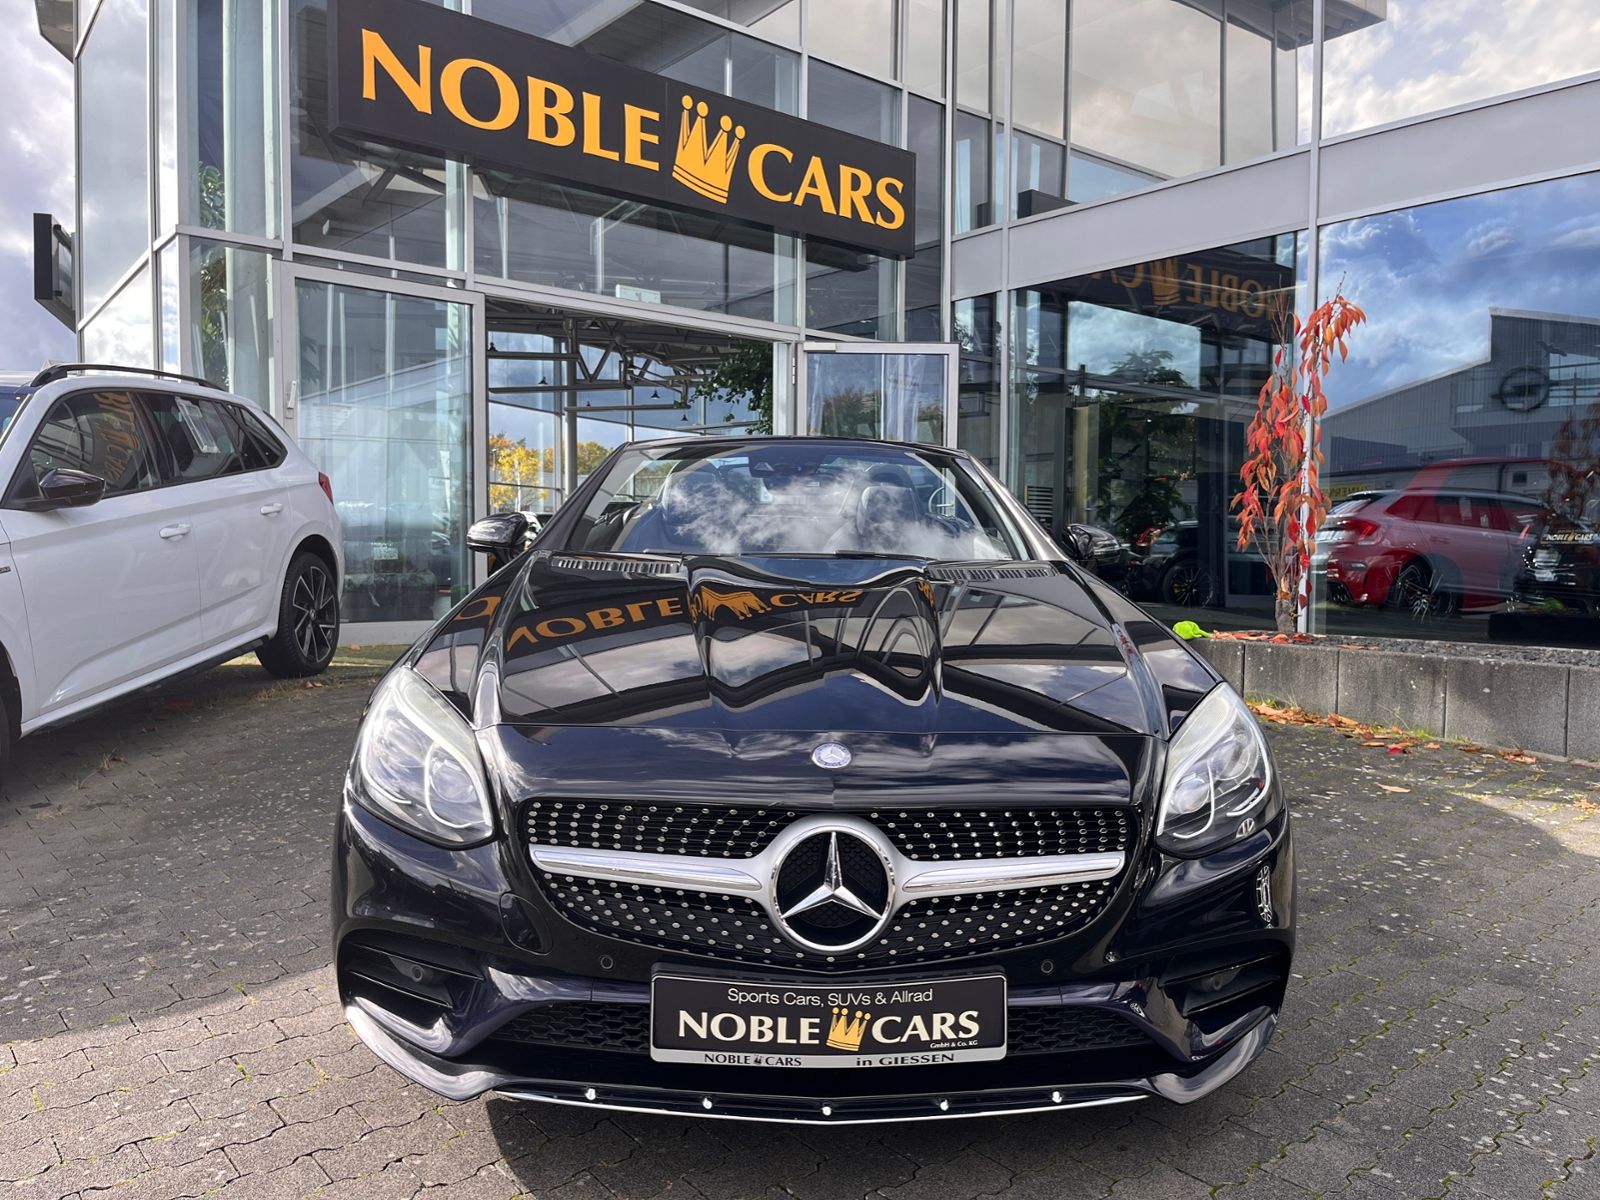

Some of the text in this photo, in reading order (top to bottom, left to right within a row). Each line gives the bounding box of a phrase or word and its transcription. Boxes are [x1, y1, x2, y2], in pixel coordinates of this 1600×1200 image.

[361, 28, 906, 230] NOBLE CARS
[727, 987, 933, 1008] Sports Cars, SUVs & Allrad
[678, 1010, 980, 1044] NOBLE CARS
[704, 1053, 802, 1067] NOBLE CARS
[856, 1053, 955, 1066] in GIESSEN
